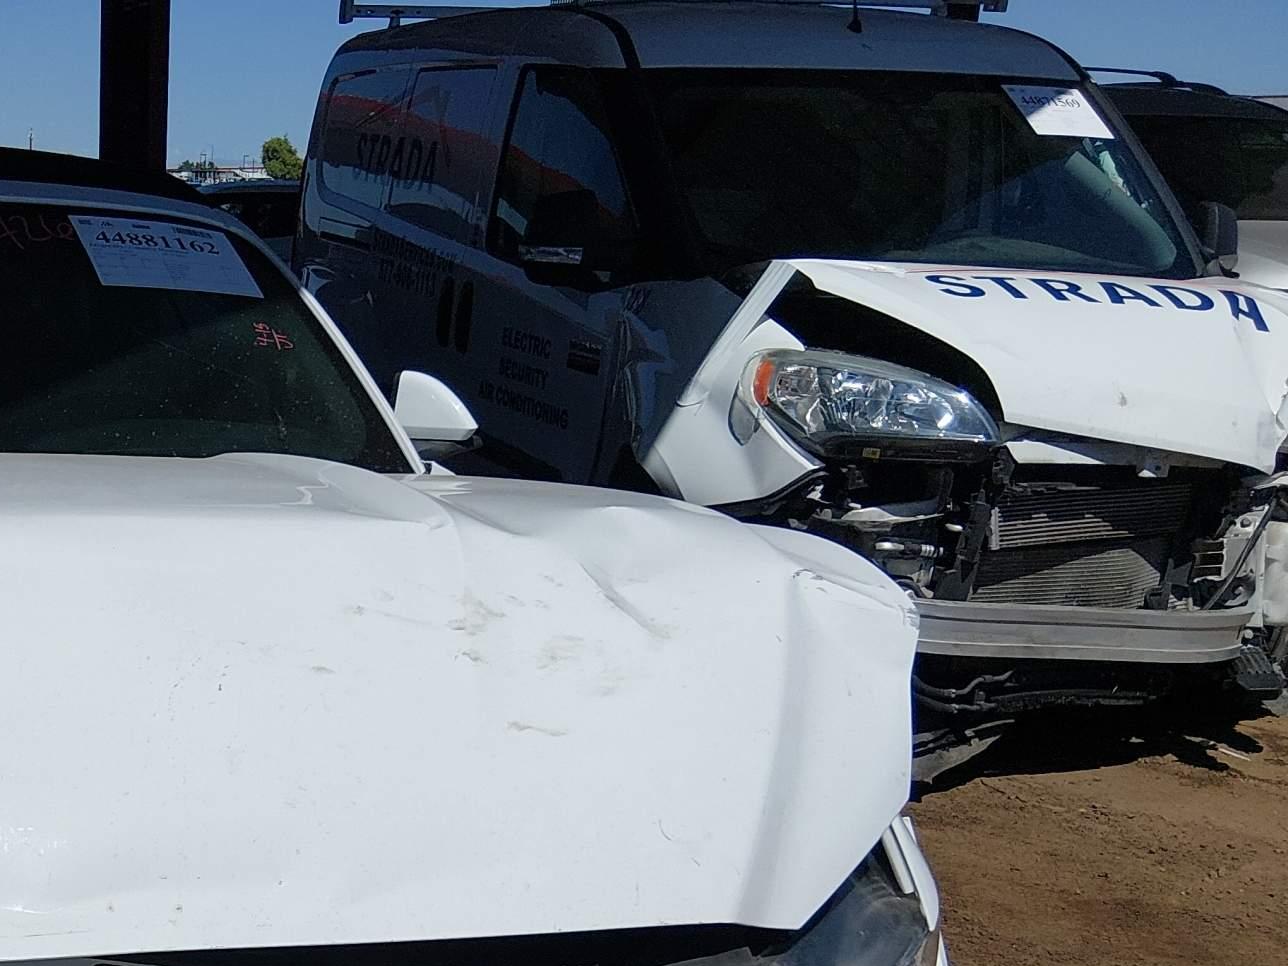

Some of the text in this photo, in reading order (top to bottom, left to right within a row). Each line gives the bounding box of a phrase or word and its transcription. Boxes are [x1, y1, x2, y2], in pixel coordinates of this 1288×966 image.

[1021, 95, 1081, 109] 44871569
[354, 132, 440, 192] STRADA
[95, 230, 220, 256] 44881162
[924, 274, 1269, 333] STRADA
[502, 327, 552, 359] ELECTRIC
[498, 356, 549, 390] SECURITY
[478, 380, 570, 429] AIR CONDITIONING
